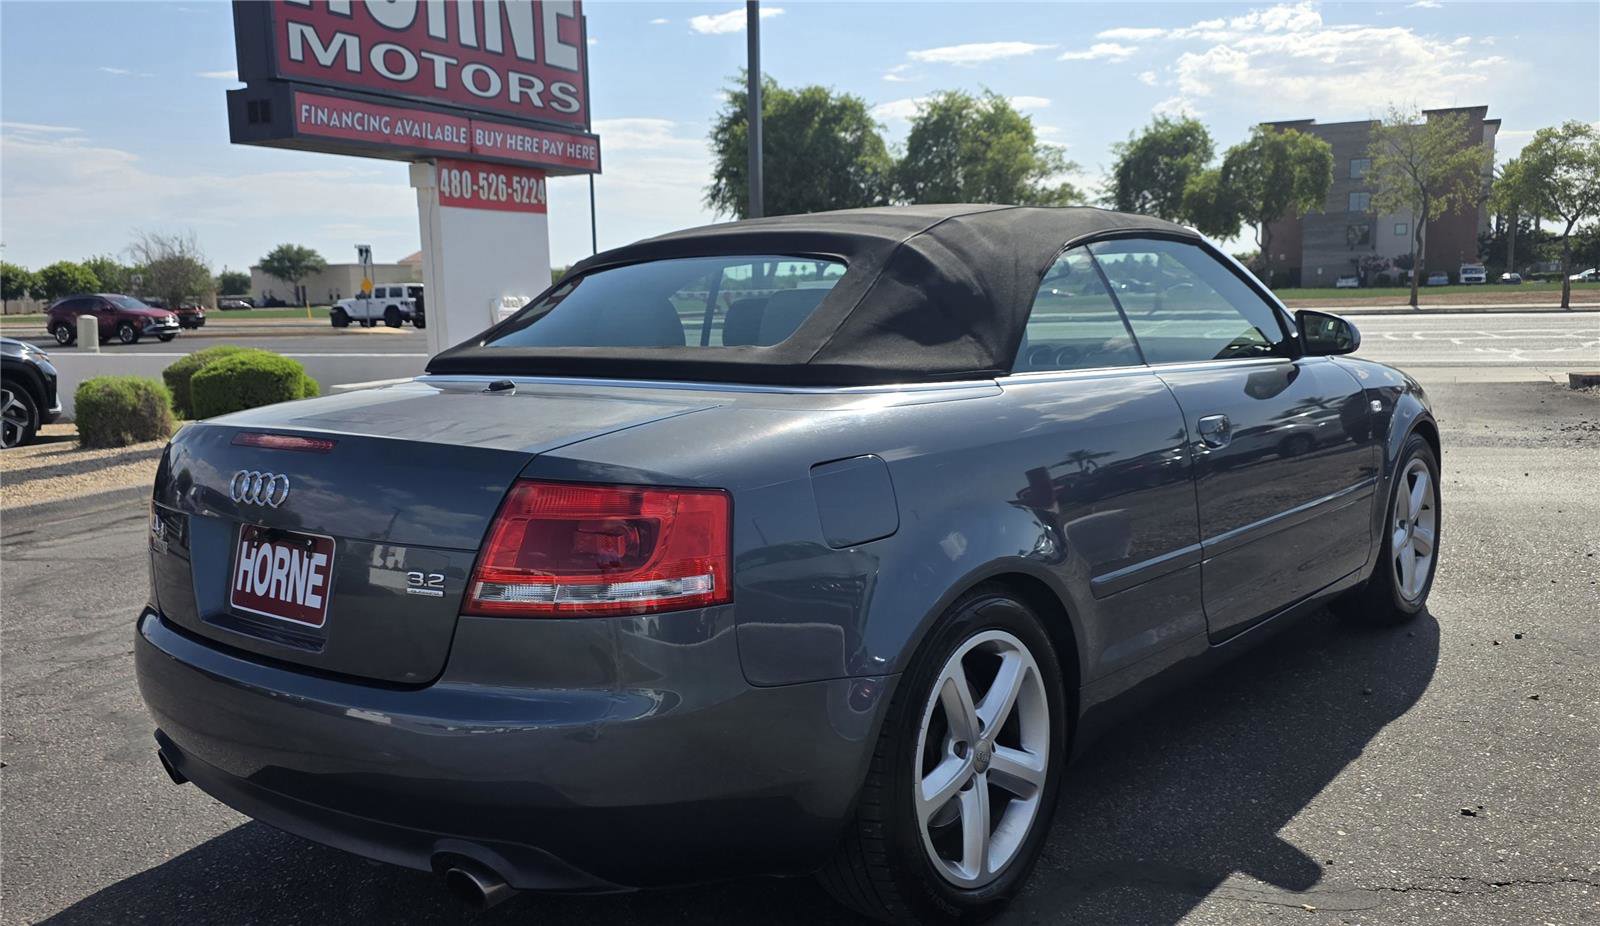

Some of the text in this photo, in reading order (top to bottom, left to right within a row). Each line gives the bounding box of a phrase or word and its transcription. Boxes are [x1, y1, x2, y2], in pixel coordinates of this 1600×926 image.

[287, 21, 581, 114] MOTORS
[301, 104, 467, 144] FINANCING AVAILABLE
[475, 128, 596, 160] BUY HERE PAY HERE
[440, 168, 546, 205] 480-526-5224
[236, 541, 328, 609] HORNE
[407, 571, 445, 588] 3.2
